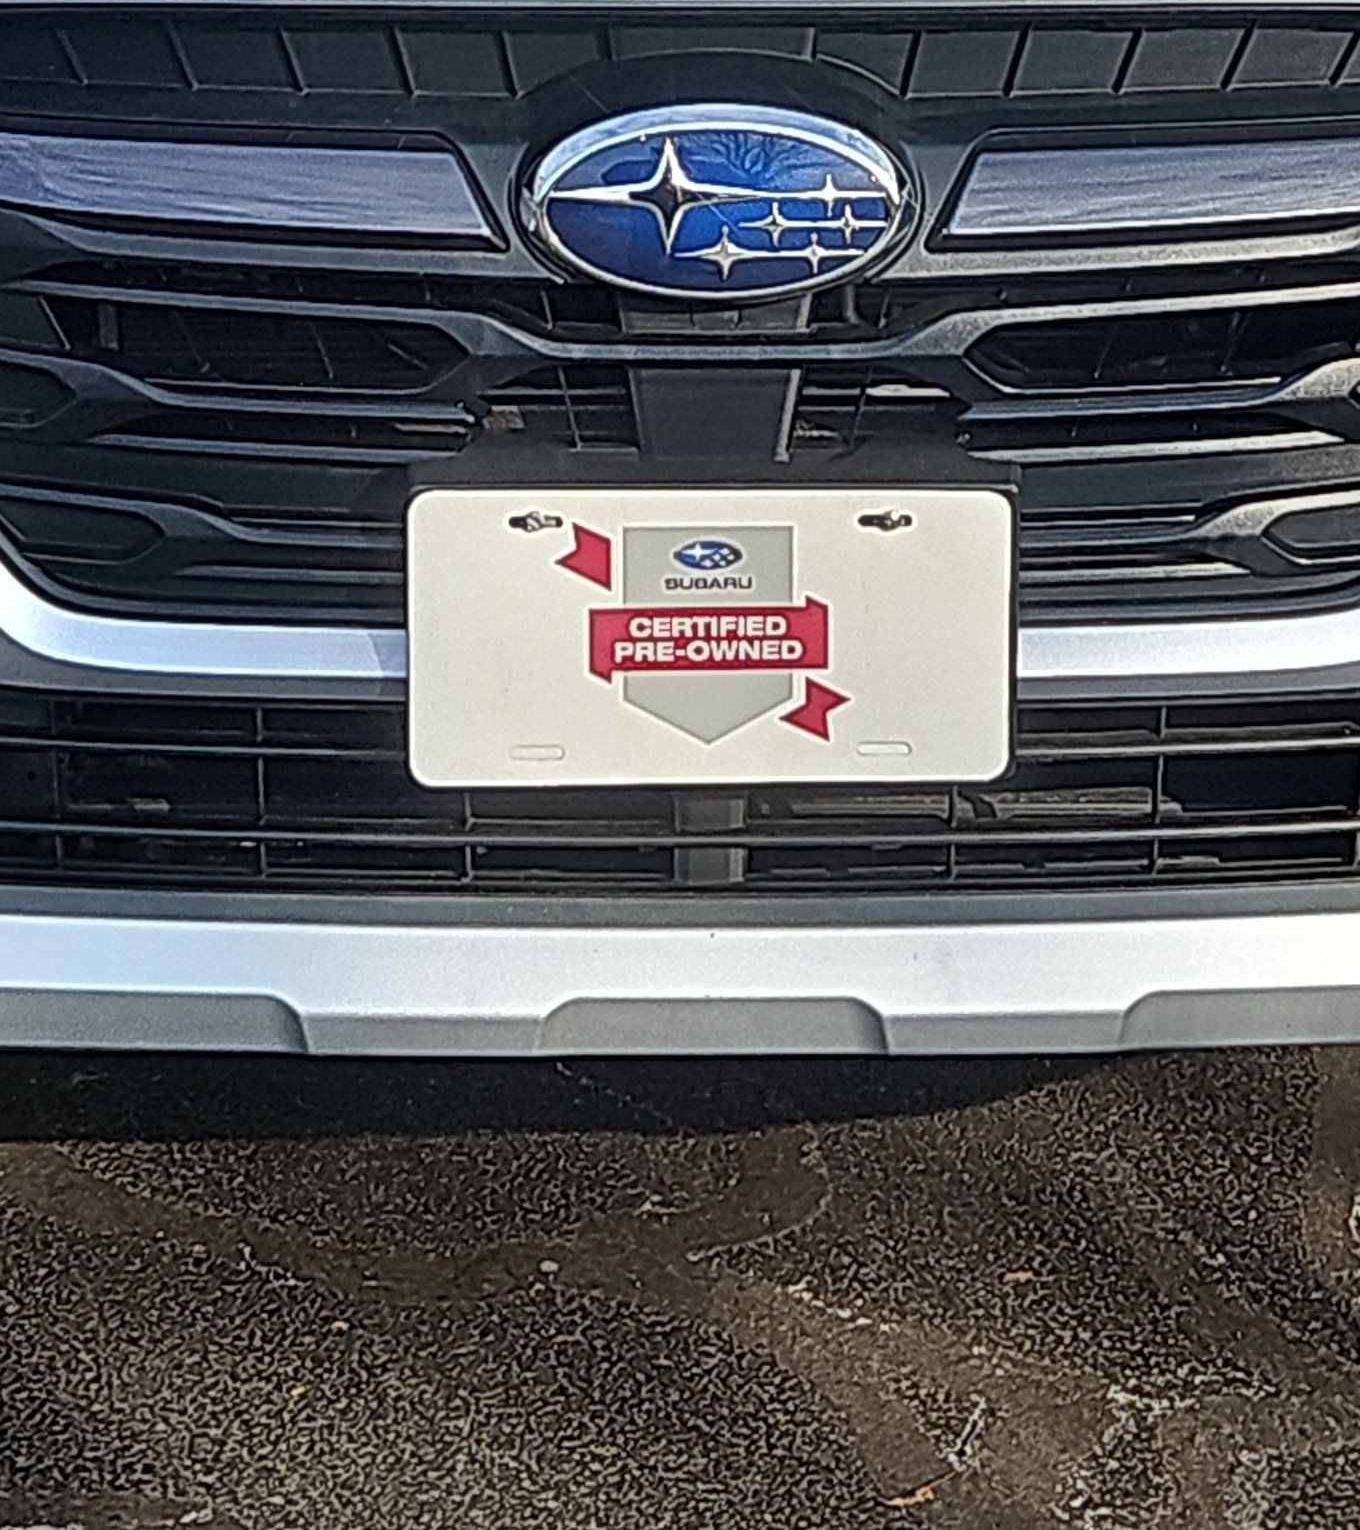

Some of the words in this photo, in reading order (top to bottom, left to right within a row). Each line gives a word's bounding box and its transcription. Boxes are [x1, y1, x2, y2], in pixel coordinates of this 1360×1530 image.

[664, 576, 753, 590] SUBARU
[628, 615, 788, 638] CERTIFIED
[613, 639, 804, 664] PRE-OWNED
